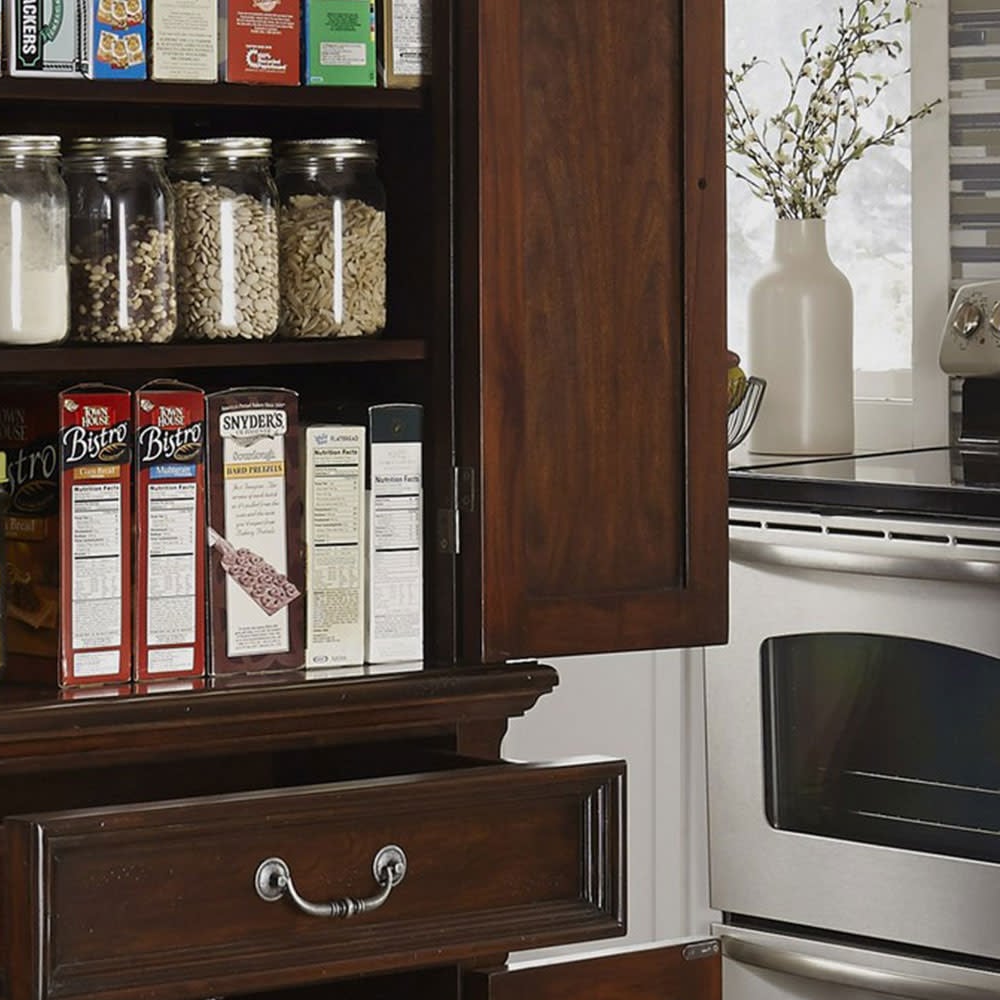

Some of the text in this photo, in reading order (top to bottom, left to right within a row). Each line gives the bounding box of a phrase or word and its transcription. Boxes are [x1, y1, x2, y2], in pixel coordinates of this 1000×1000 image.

[223, 412, 284, 431] SNYDER'S
[62, 423, 127, 462] Bistro
[139, 423, 202, 462] Bistro
[7, 445, 57, 496] stro
